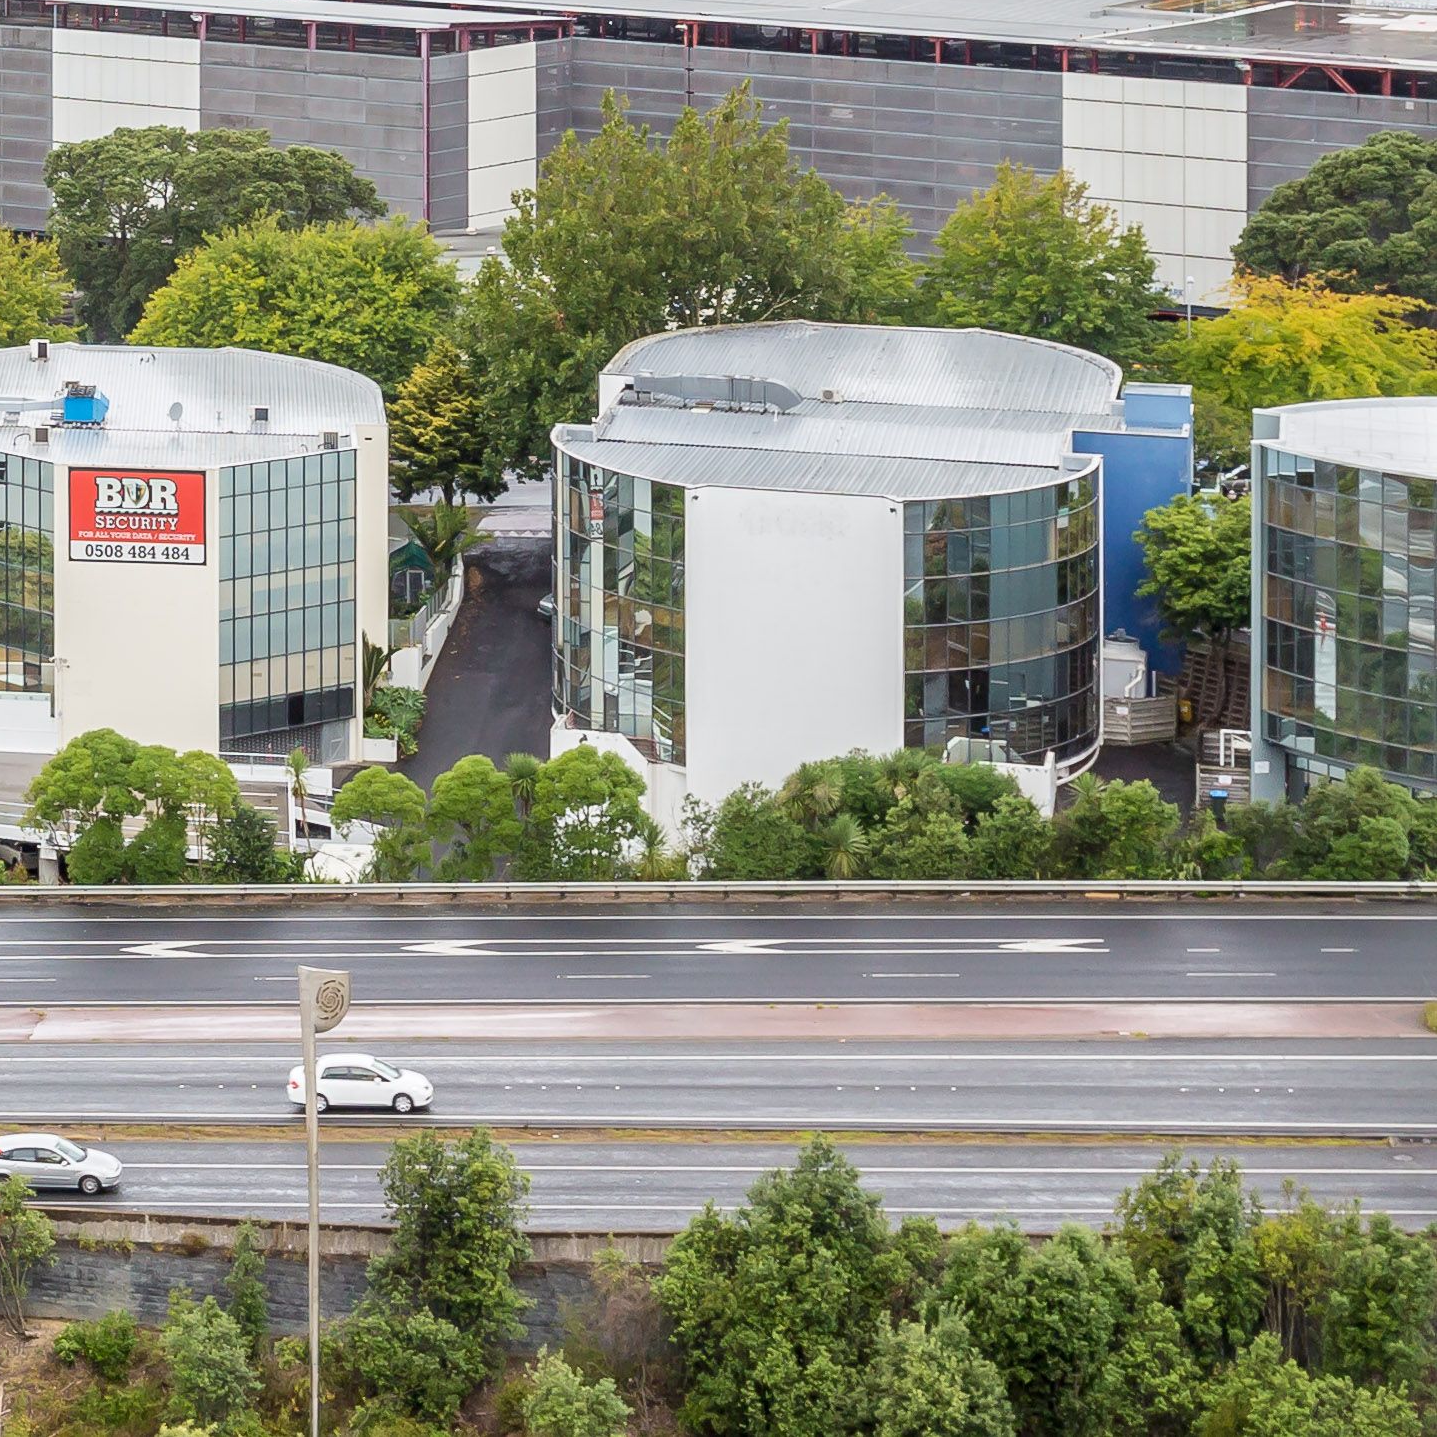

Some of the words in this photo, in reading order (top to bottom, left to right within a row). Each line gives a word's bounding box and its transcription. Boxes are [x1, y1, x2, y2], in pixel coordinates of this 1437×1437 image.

[95, 477, 178, 510] BDR
[95, 515, 179, 529] SECURITY
[78, 530, 94, 538] FOR
[95, 531, 110, 539] ALL
[159, 534, 196, 542] SECURITY
[85, 543, 123, 558] 0508
[128, 544, 156, 559] 484
[161, 546, 190, 560] 484
